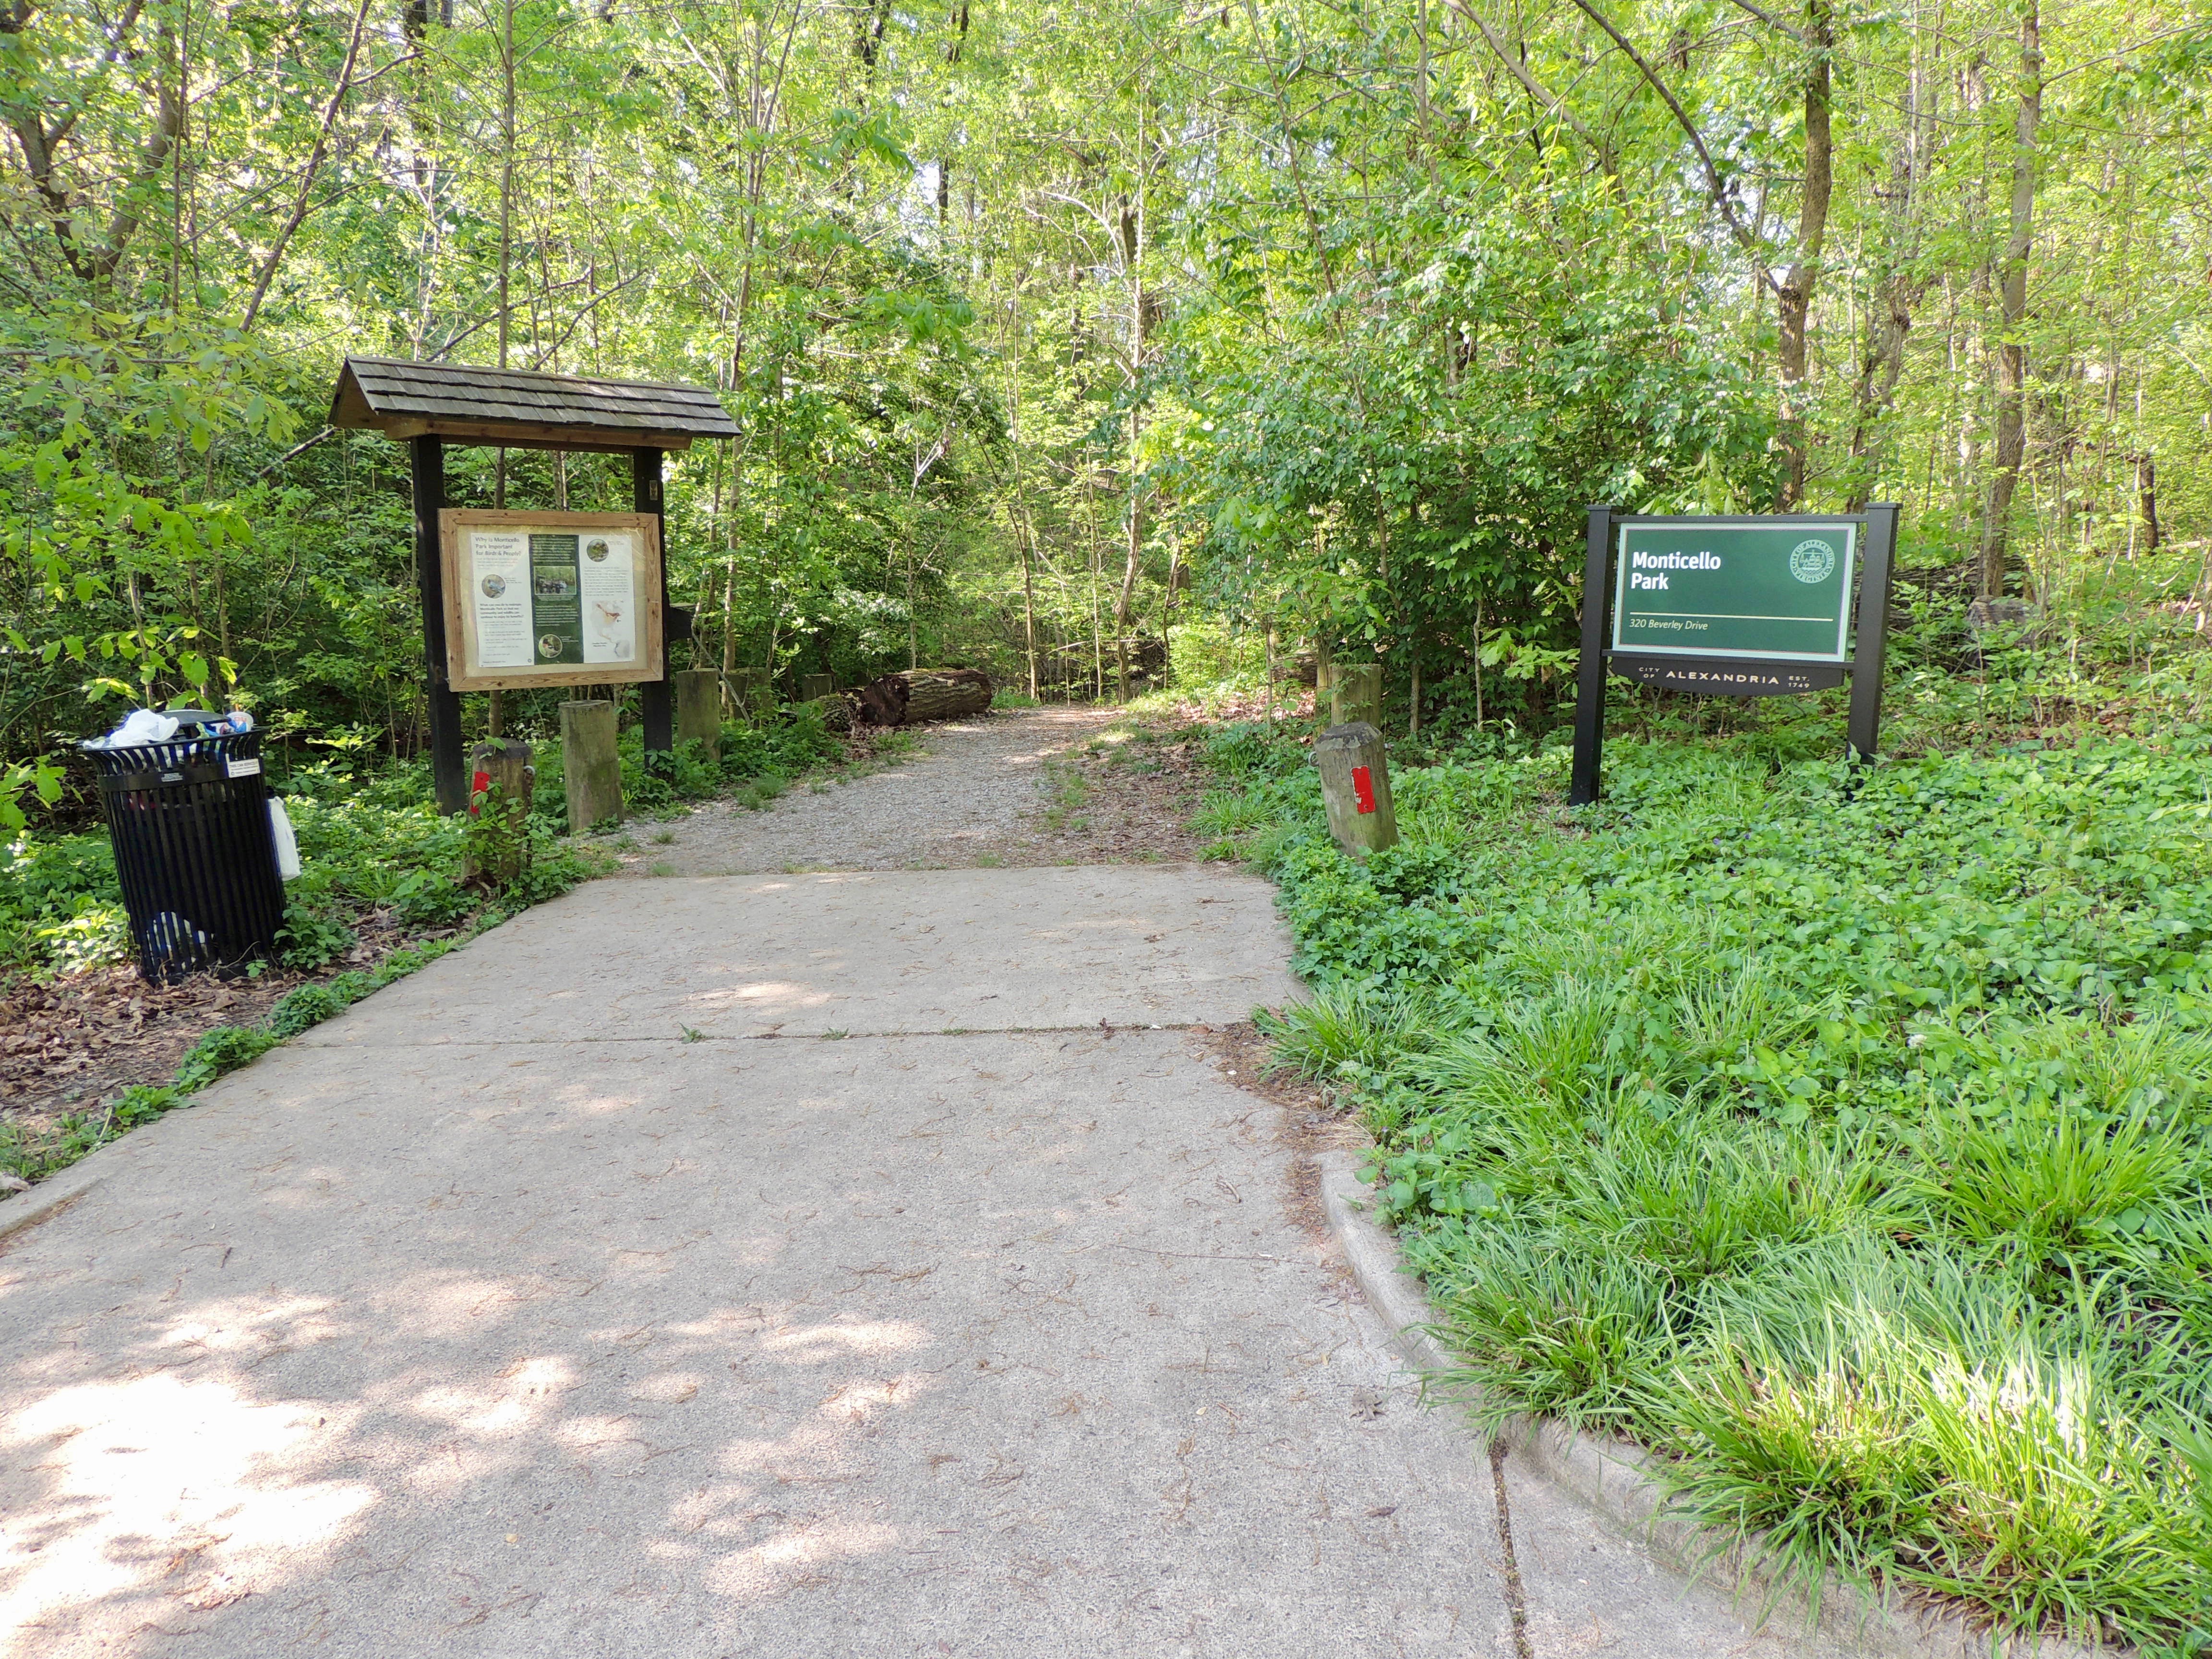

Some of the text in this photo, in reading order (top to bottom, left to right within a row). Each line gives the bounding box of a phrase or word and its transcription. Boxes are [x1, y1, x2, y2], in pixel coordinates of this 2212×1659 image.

[1632, 552, 1721, 569] Monticello
[1631, 572, 1669, 590] Park
[1629, 619, 1708, 631] 320 Beverley Drive
[1666, 670, 1779, 685] ALEXANDRIA
